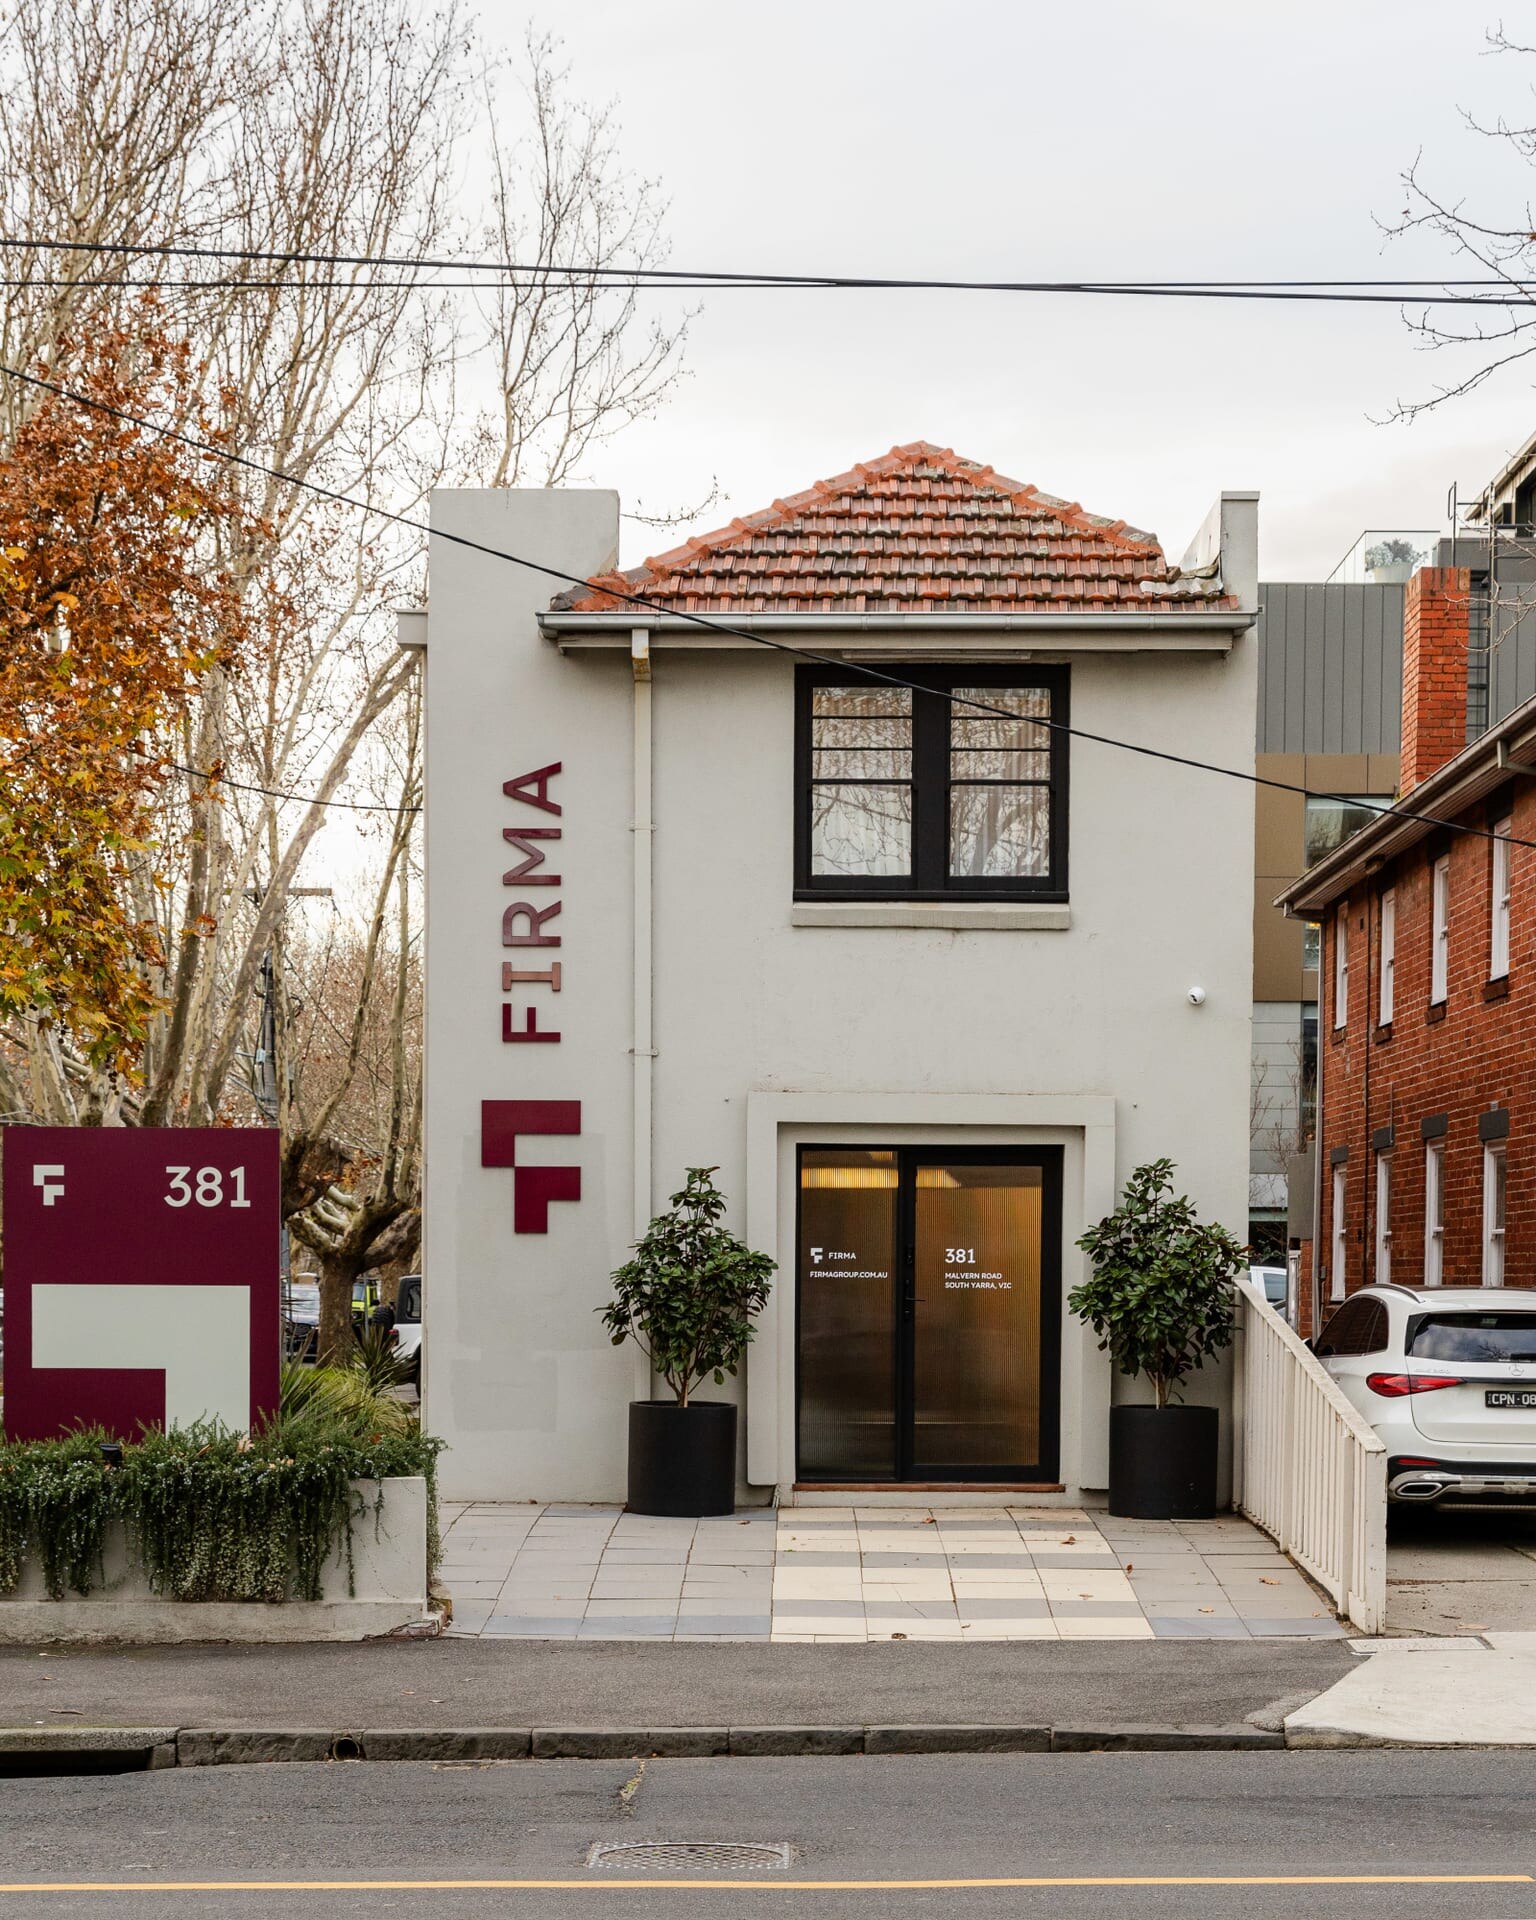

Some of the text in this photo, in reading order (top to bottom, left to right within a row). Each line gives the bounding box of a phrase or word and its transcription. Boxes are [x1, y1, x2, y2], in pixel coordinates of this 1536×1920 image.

[502, 761, 562, 1042] FIRMA
[164, 1166, 251, 1208] 381
[828, 1252, 857, 1260] FIRMA
[944, 1248, 976, 1264] 381
[809, 1271, 888, 1279] FIRMAGROUP.COM.AU
[944, 1272, 1003, 1280] MALVERN ROAD
[944, 1281, 970, 1289] SOUTH
[970, 1281, 998, 1290] YARRA,
[1491, 1393, 1515, 1405] CPN
